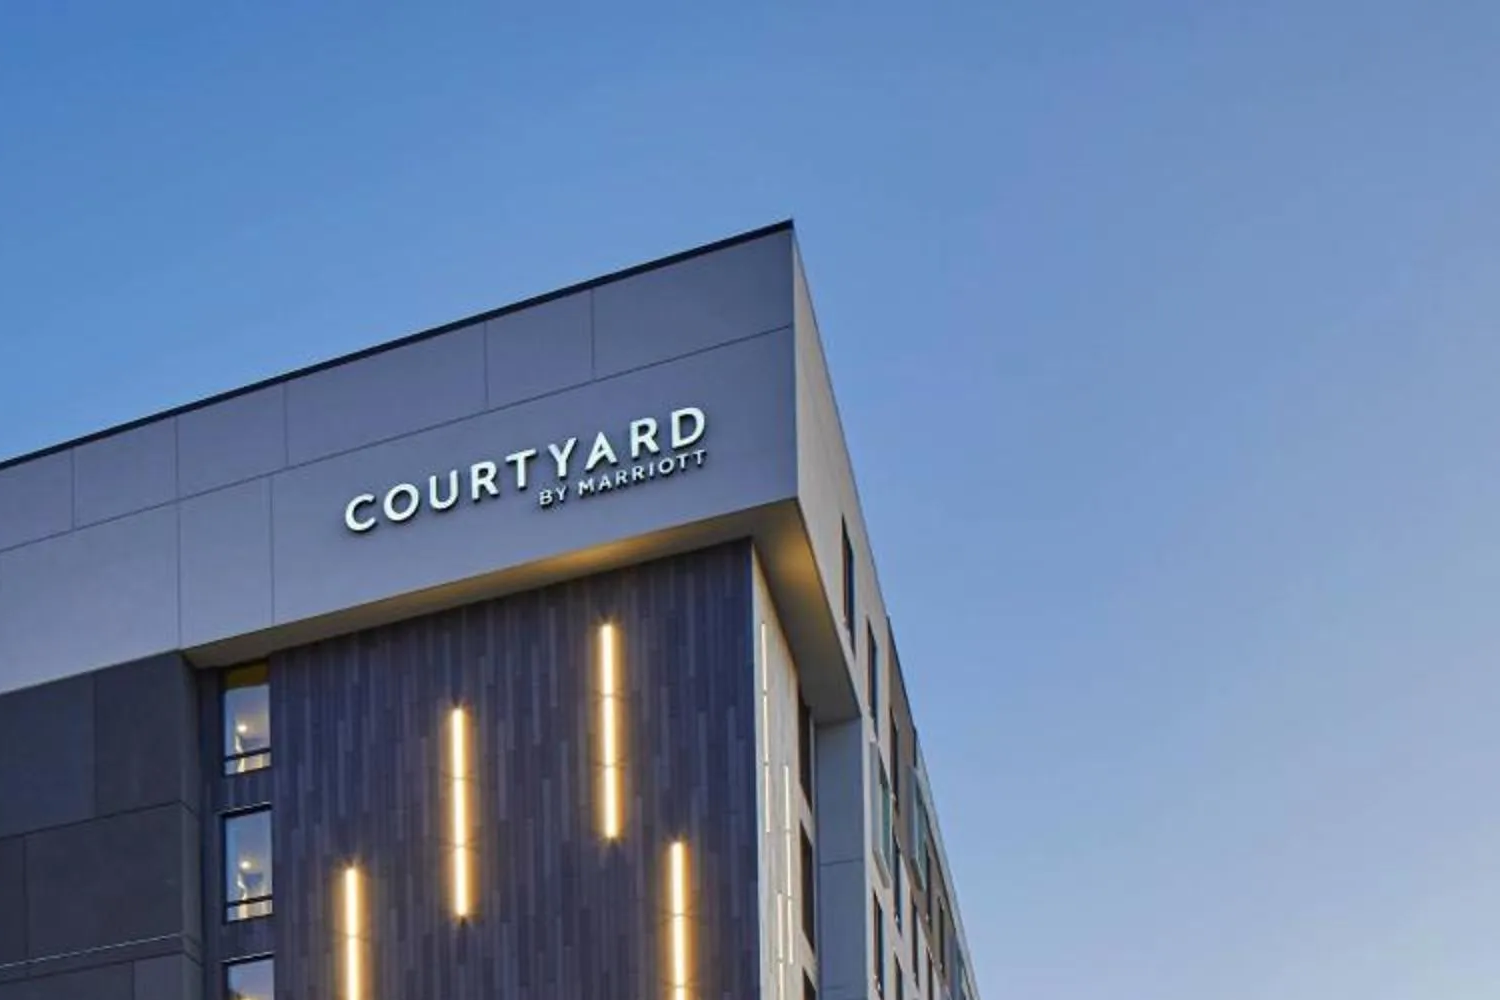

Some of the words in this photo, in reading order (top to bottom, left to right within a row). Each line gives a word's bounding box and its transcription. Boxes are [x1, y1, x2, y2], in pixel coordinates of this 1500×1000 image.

[344, 406, 706, 532] COURTYARD
[539, 486, 566, 506] BY
[578, 449, 706, 496] MARRIOTT
